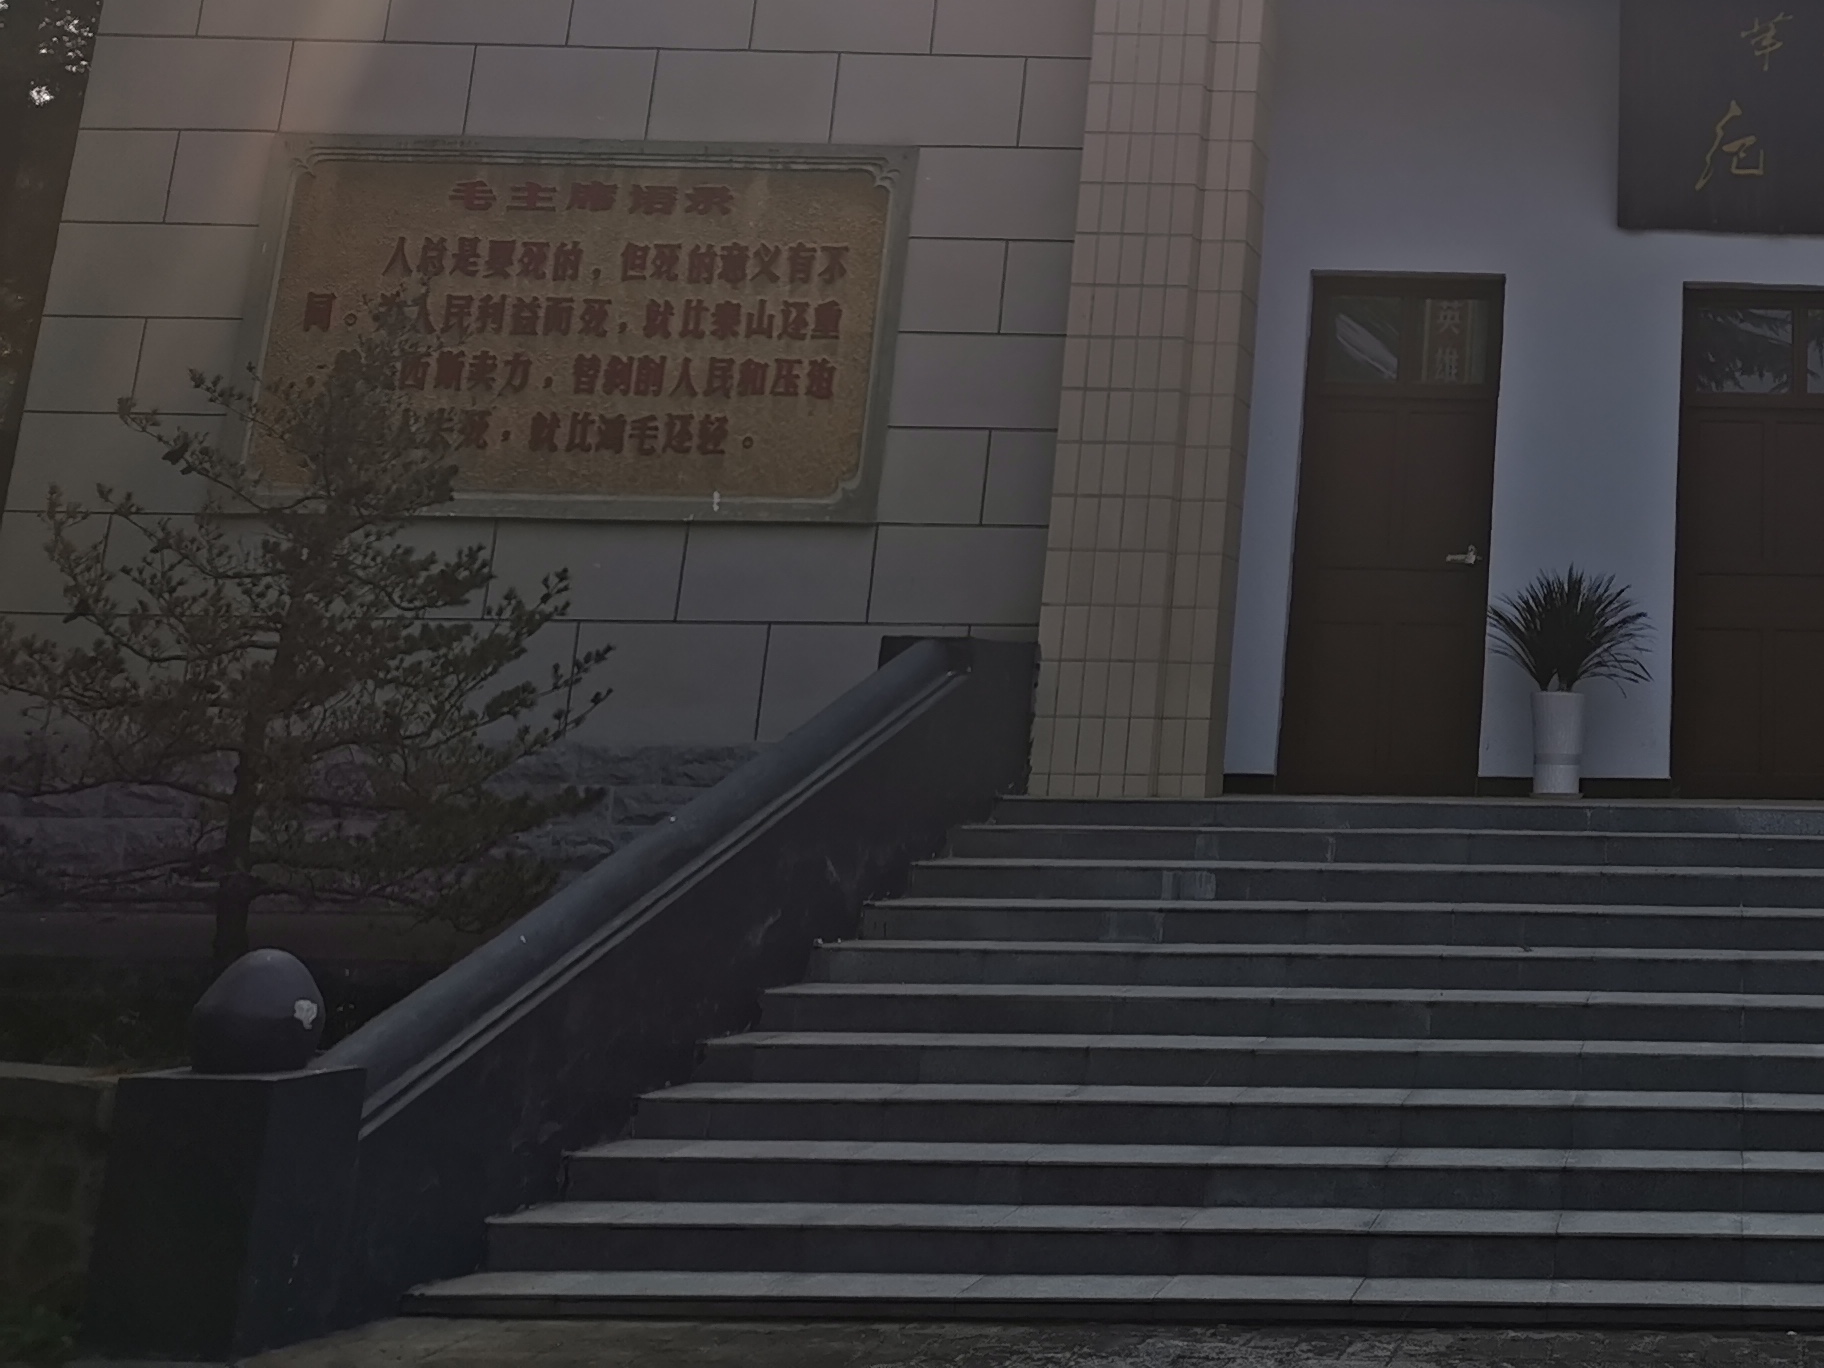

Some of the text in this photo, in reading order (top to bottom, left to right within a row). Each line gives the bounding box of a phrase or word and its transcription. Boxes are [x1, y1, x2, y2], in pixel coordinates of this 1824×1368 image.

[449, 180, 734, 215] 毛主席语录
